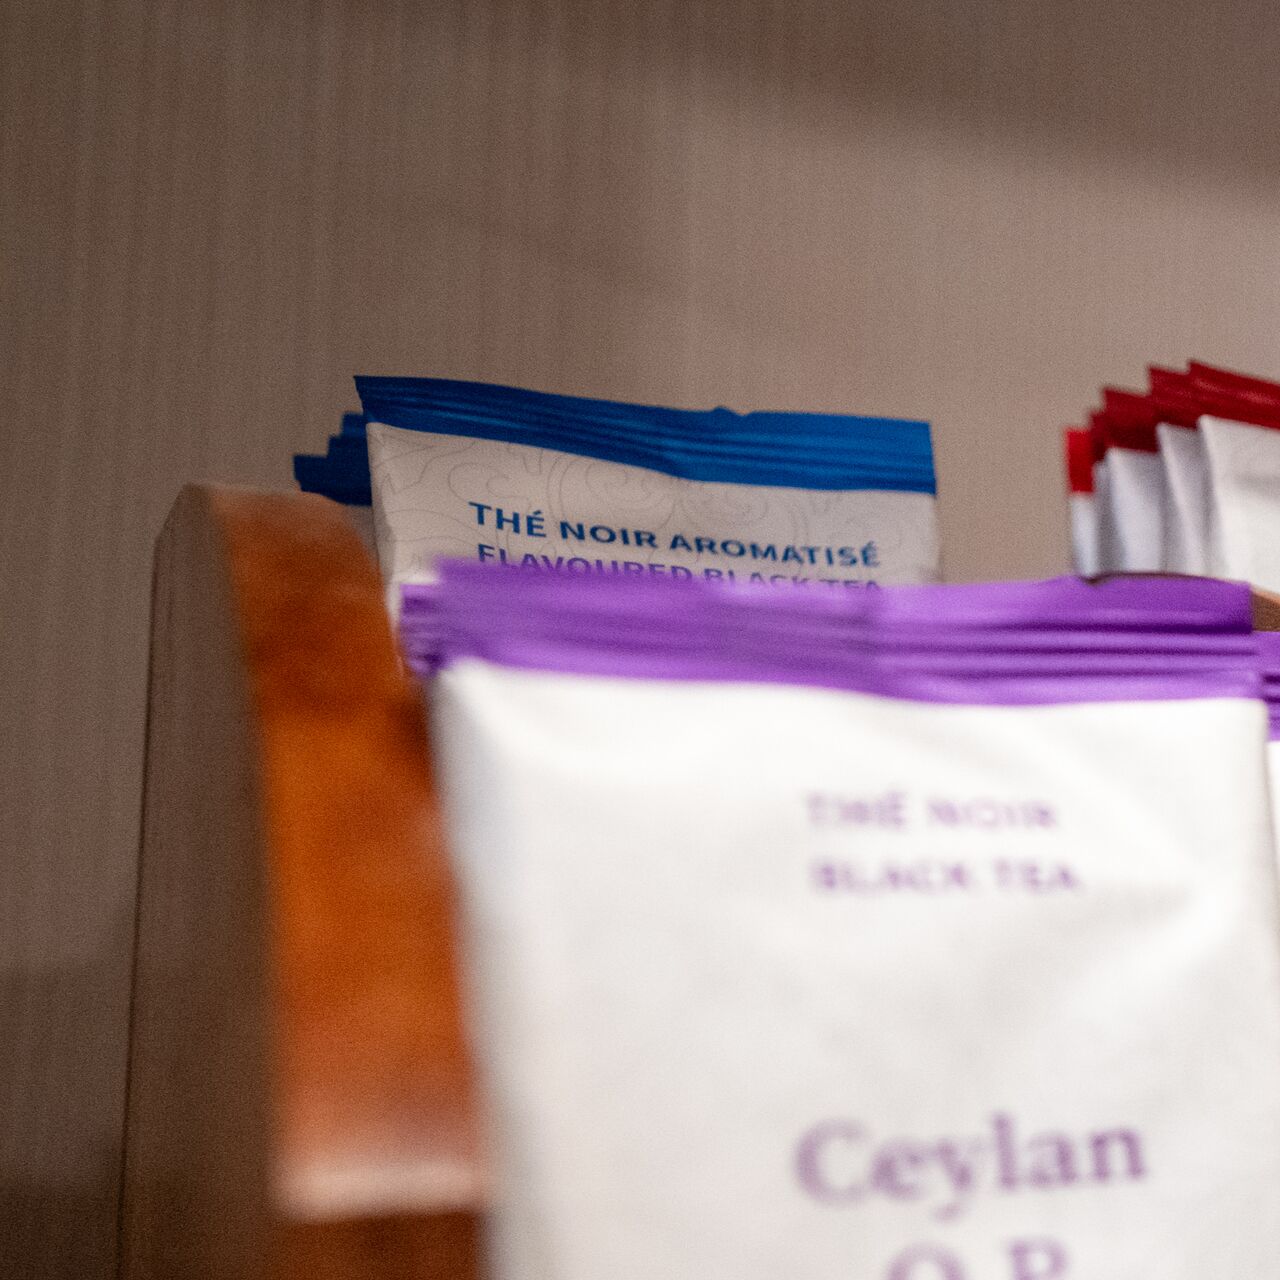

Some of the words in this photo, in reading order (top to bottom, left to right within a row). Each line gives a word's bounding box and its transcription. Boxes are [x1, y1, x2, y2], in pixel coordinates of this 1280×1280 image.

[468, 501, 547, 538] THÉ
[560, 520, 659, 549] NOIR
[669, 533, 881, 568] AROMATISÉ
[927, 797, 1057, 830] NOIR
[809, 858, 970, 893] BLACK
[995, 857, 1081, 893] TEA
[794, 1112, 1148, 1225] Ceylan
